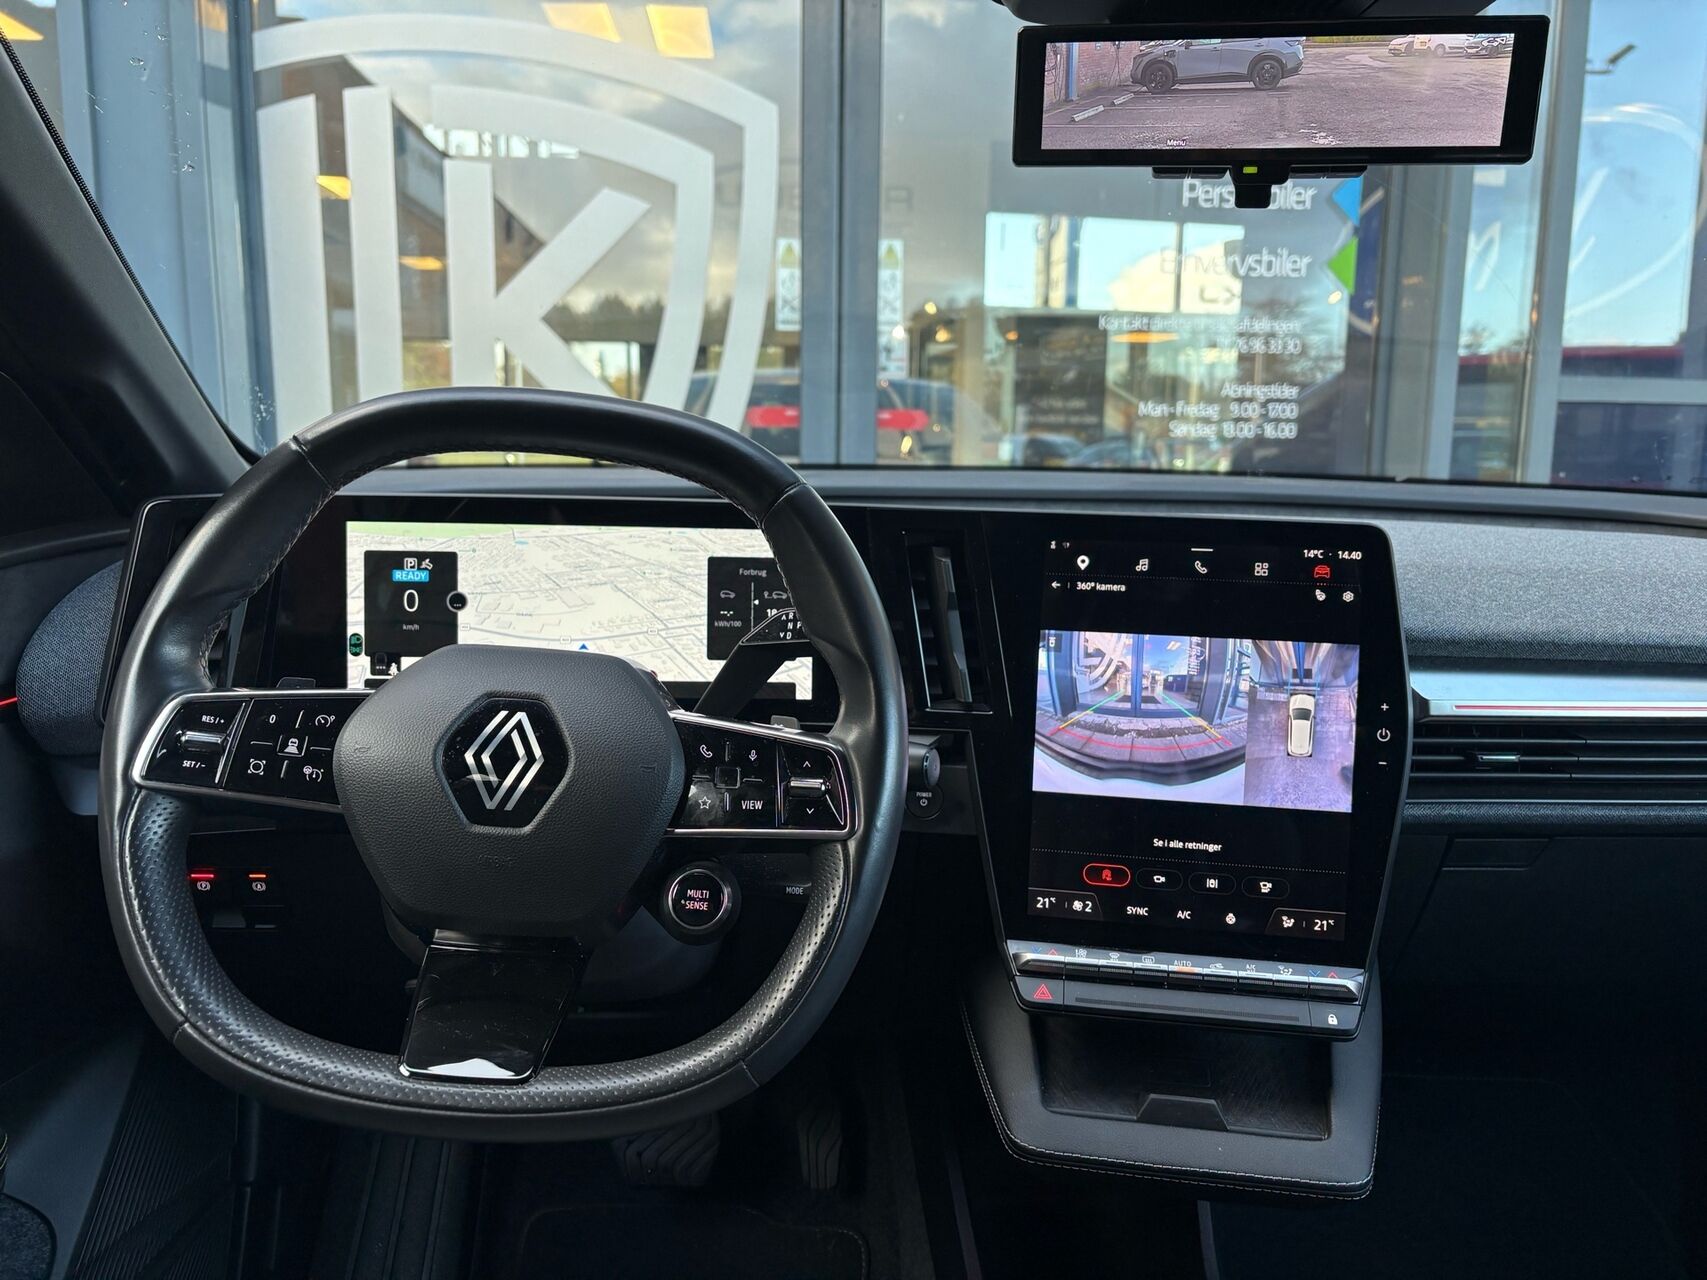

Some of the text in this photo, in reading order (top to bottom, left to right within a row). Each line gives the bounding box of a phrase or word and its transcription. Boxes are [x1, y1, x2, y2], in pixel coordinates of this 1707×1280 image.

[1303, 550, 1362, 560] 14°C 14.40
[395, 572, 426, 581] READY
[739, 568, 767, 577] Forbrug
[1096, 584, 1126, 592] kamera
[404, 590, 419, 612] 0
[741, 800, 763, 810] VIEW
[1153, 838, 1164, 847] Se
[1169, 840, 1183, 849] alle
[1184, 842, 1222, 853] retninger
[687, 889, 709, 899] MULTI
[786, 886, 804, 895] MODE
[685, 901, 709, 911] SENSE
[1126, 906, 1149, 916] SYNC
[1176, 910, 1192, 920] A/C
[1173, 959, 1192, 968] AUTO
